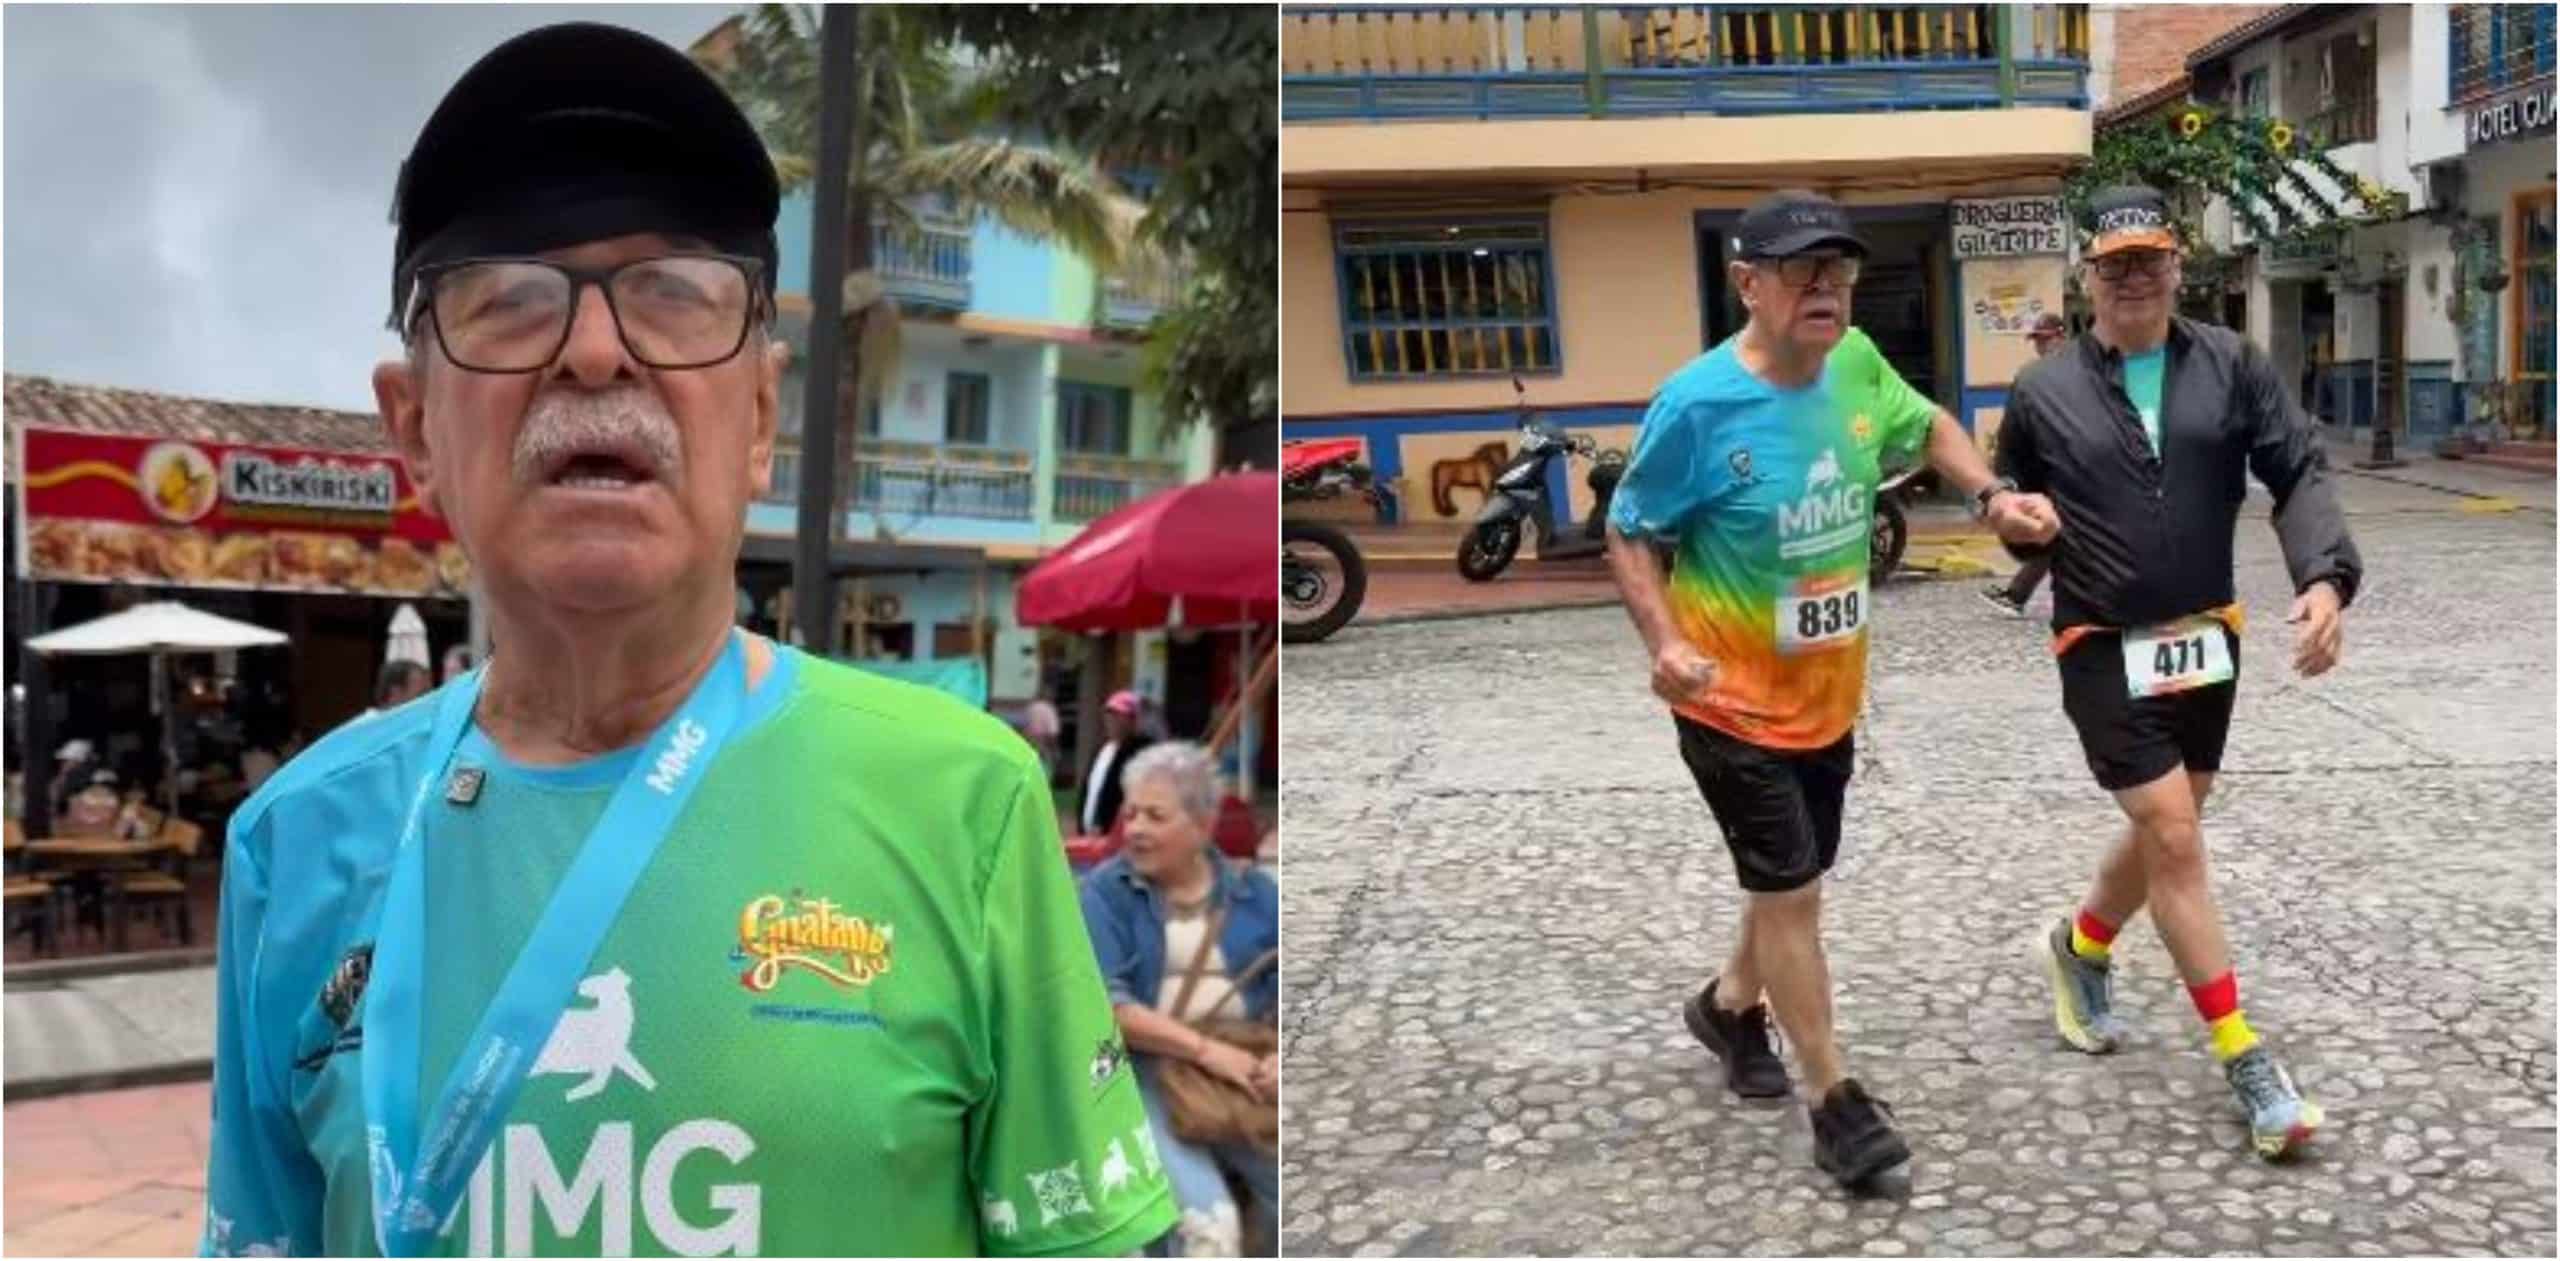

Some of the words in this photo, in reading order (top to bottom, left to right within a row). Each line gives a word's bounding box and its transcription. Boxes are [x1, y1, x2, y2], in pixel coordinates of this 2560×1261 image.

[2469, 99, 2519, 142] HOTEL
[1778, 482, 1865, 538] MMG
[1797, 590, 1859, 638] 839
[2153, 636, 2205, 677] 471
[644, 717, 708, 796] MMG
